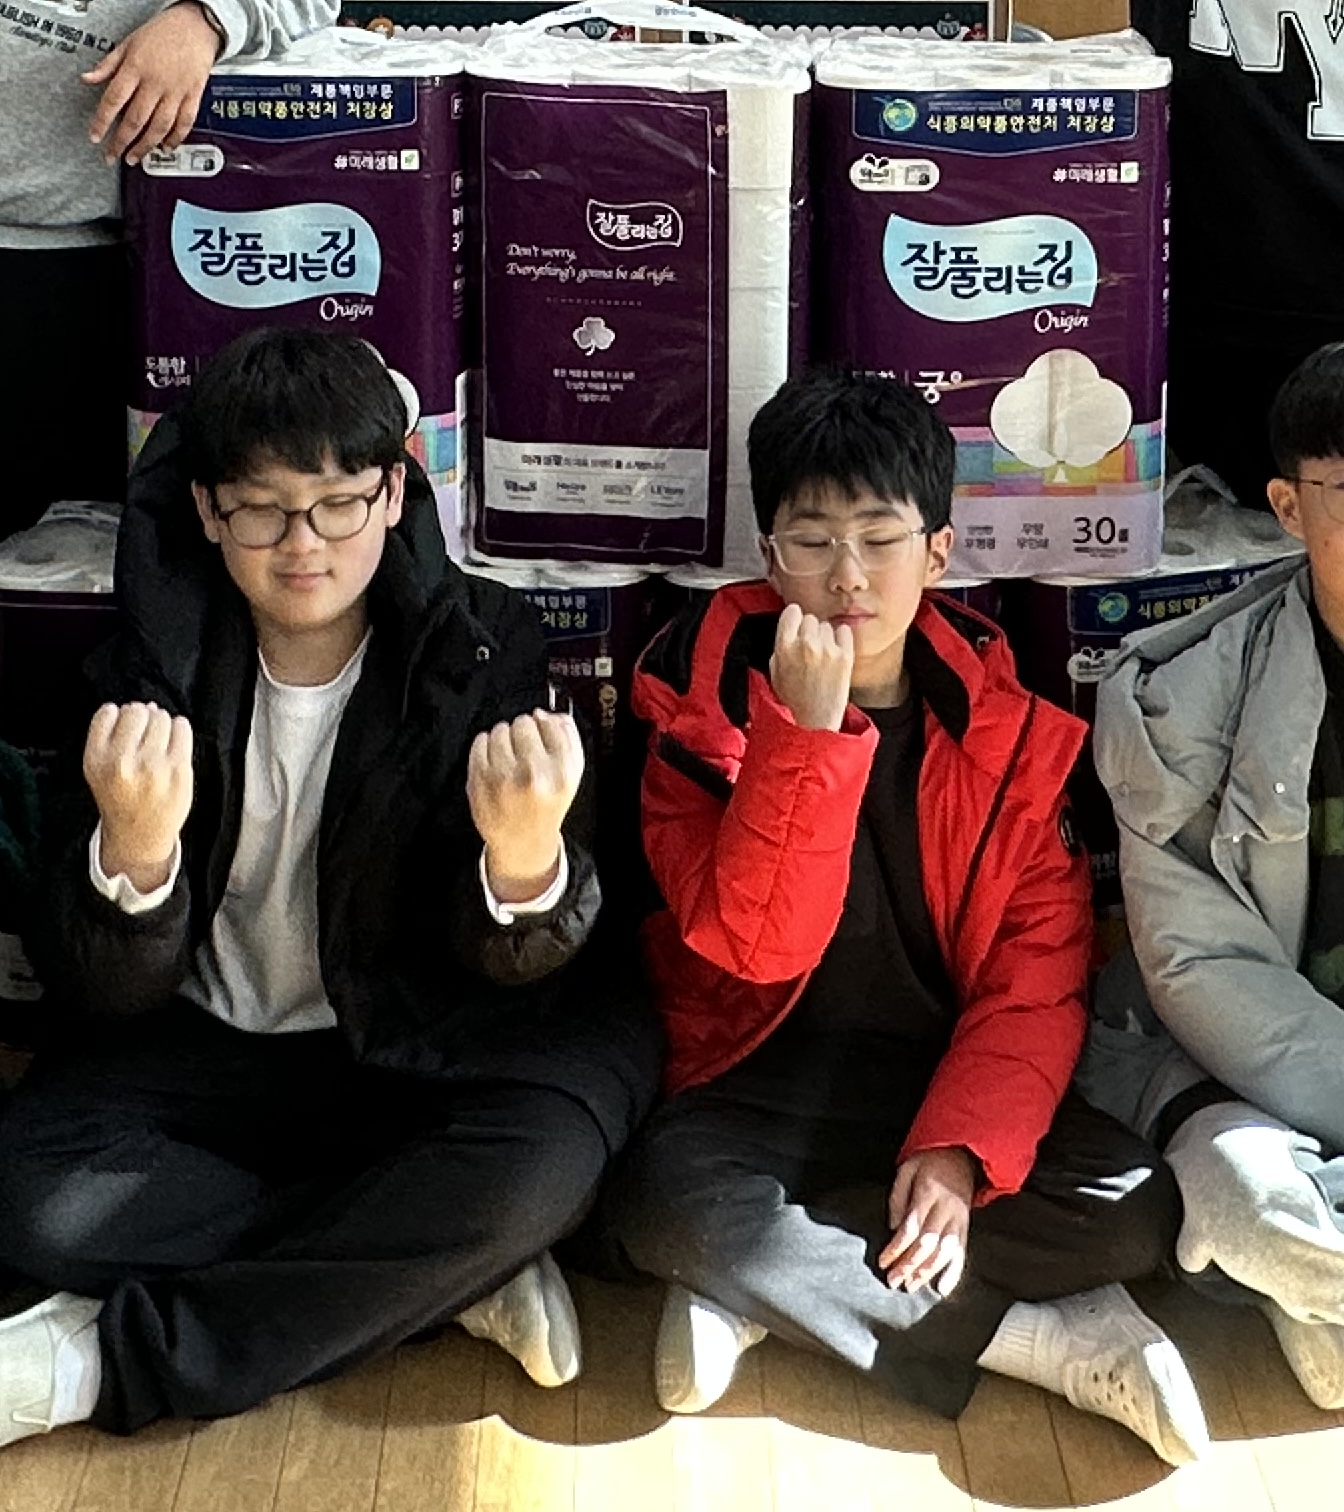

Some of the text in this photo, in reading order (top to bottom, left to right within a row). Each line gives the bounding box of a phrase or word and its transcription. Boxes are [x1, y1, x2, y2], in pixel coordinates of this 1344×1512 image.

[188, 226, 356, 285] 잘풀리는집
[900, 240, 1073, 297] 잘풀리는집
[319, 296, 374, 322] Origin
[1034, 308, 1090, 334] Origin
